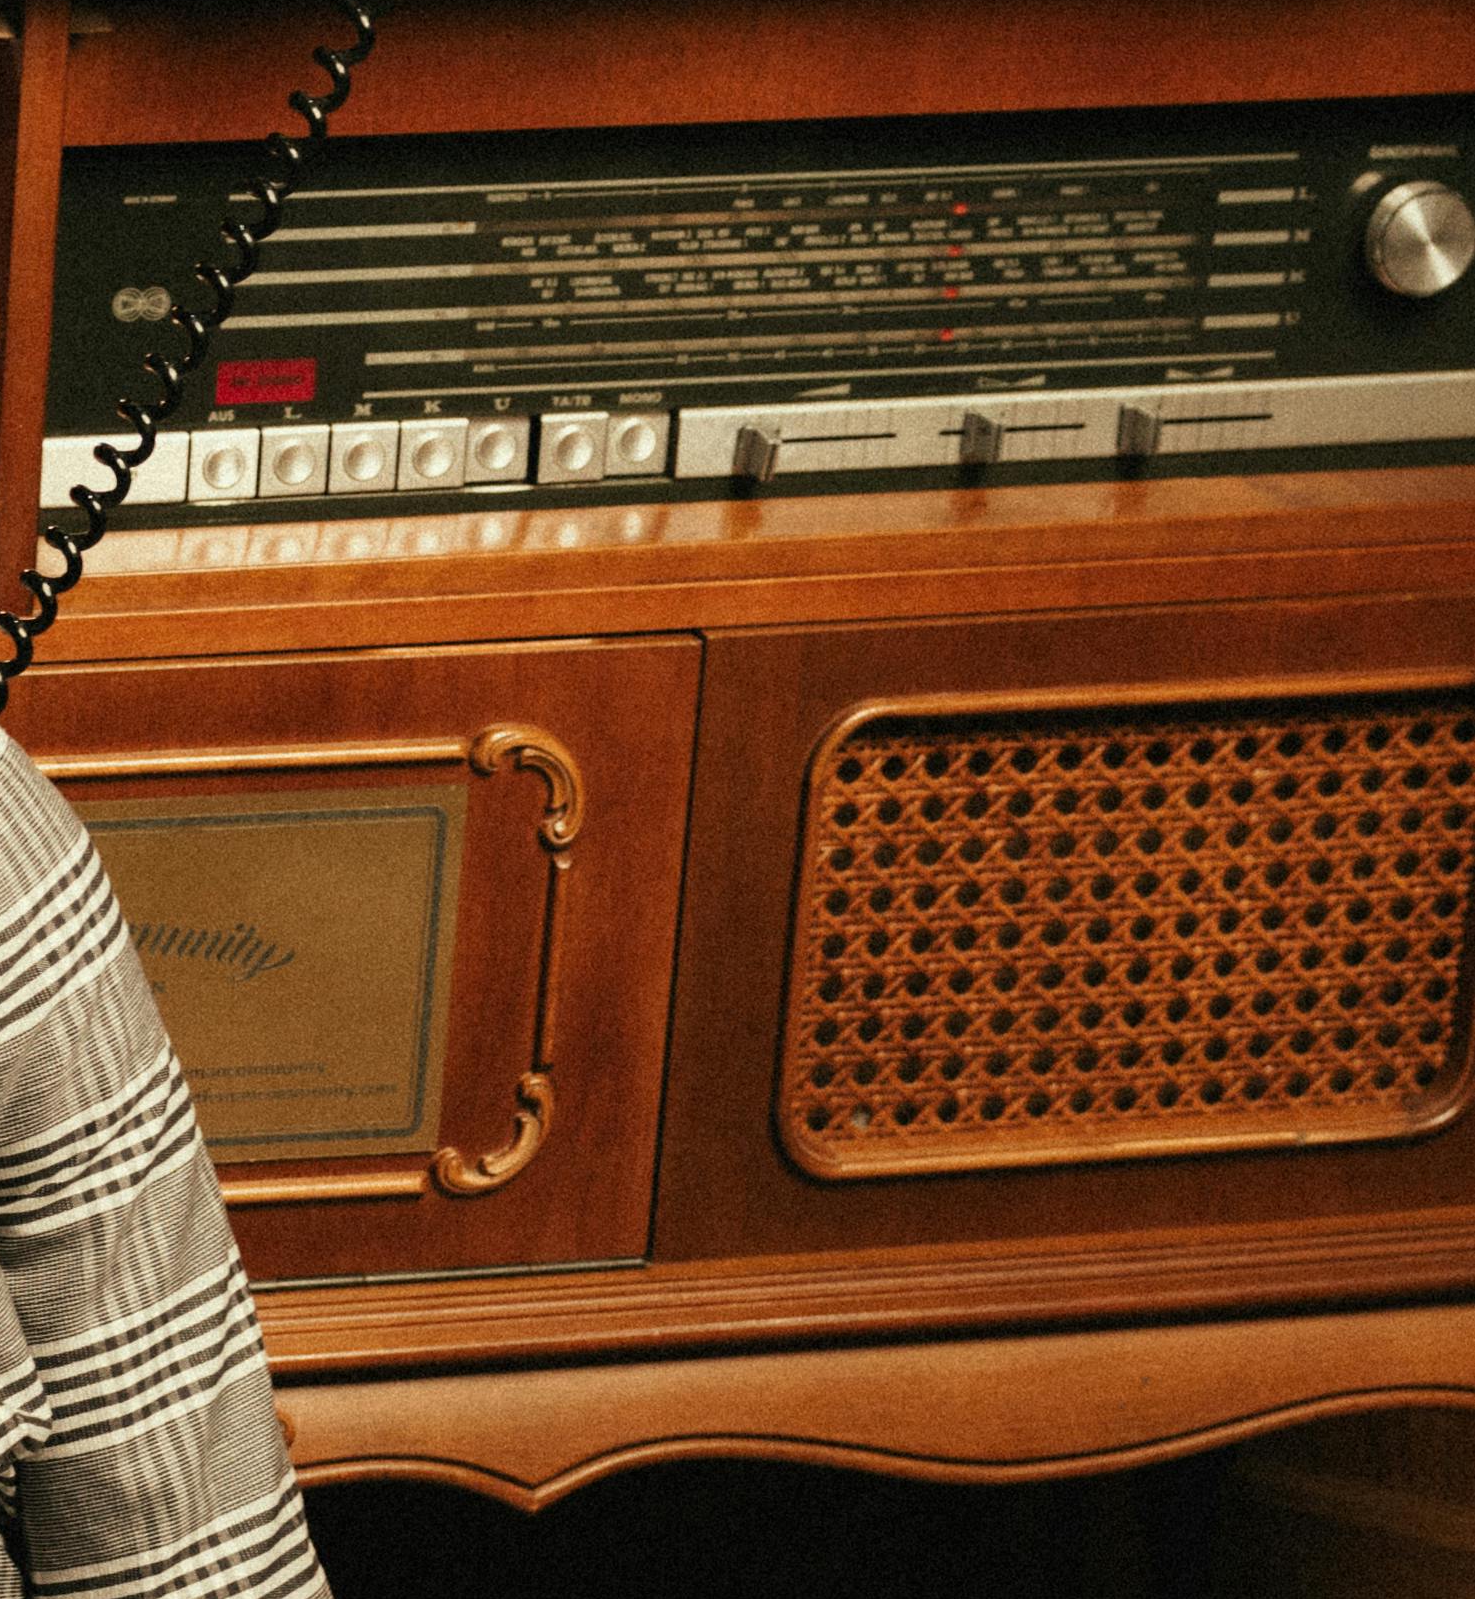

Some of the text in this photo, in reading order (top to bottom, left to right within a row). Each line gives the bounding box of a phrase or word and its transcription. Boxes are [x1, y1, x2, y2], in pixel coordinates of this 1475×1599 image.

[208, 409, 235, 423] AUS
[284, 406, 303, 420] L
[354, 402, 373, 417] M
[423, 399, 442, 414] K
[493, 397, 512, 412] U
[618, 391, 663, 405] MONO
[129, 923, 295, 982] munity
